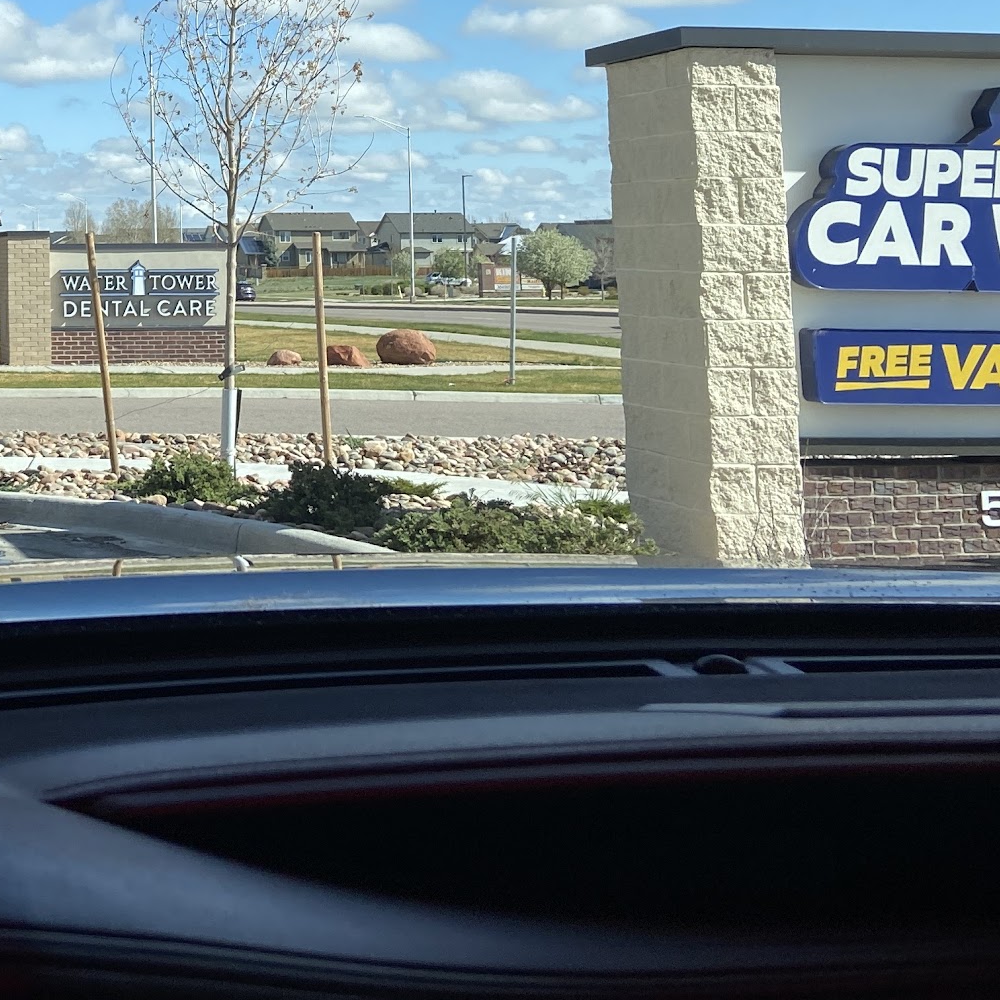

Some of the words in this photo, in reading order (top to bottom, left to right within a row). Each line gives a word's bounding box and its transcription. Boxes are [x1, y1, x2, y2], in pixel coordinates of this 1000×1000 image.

[845, 146, 1000, 198] SUPE
[807, 200, 973, 266] CAR
[61, 274, 128, 291] WAER
[149, 274, 219, 291] TOWER
[157, 299, 217, 317] CARE
[836, 344, 933, 379] FREE
